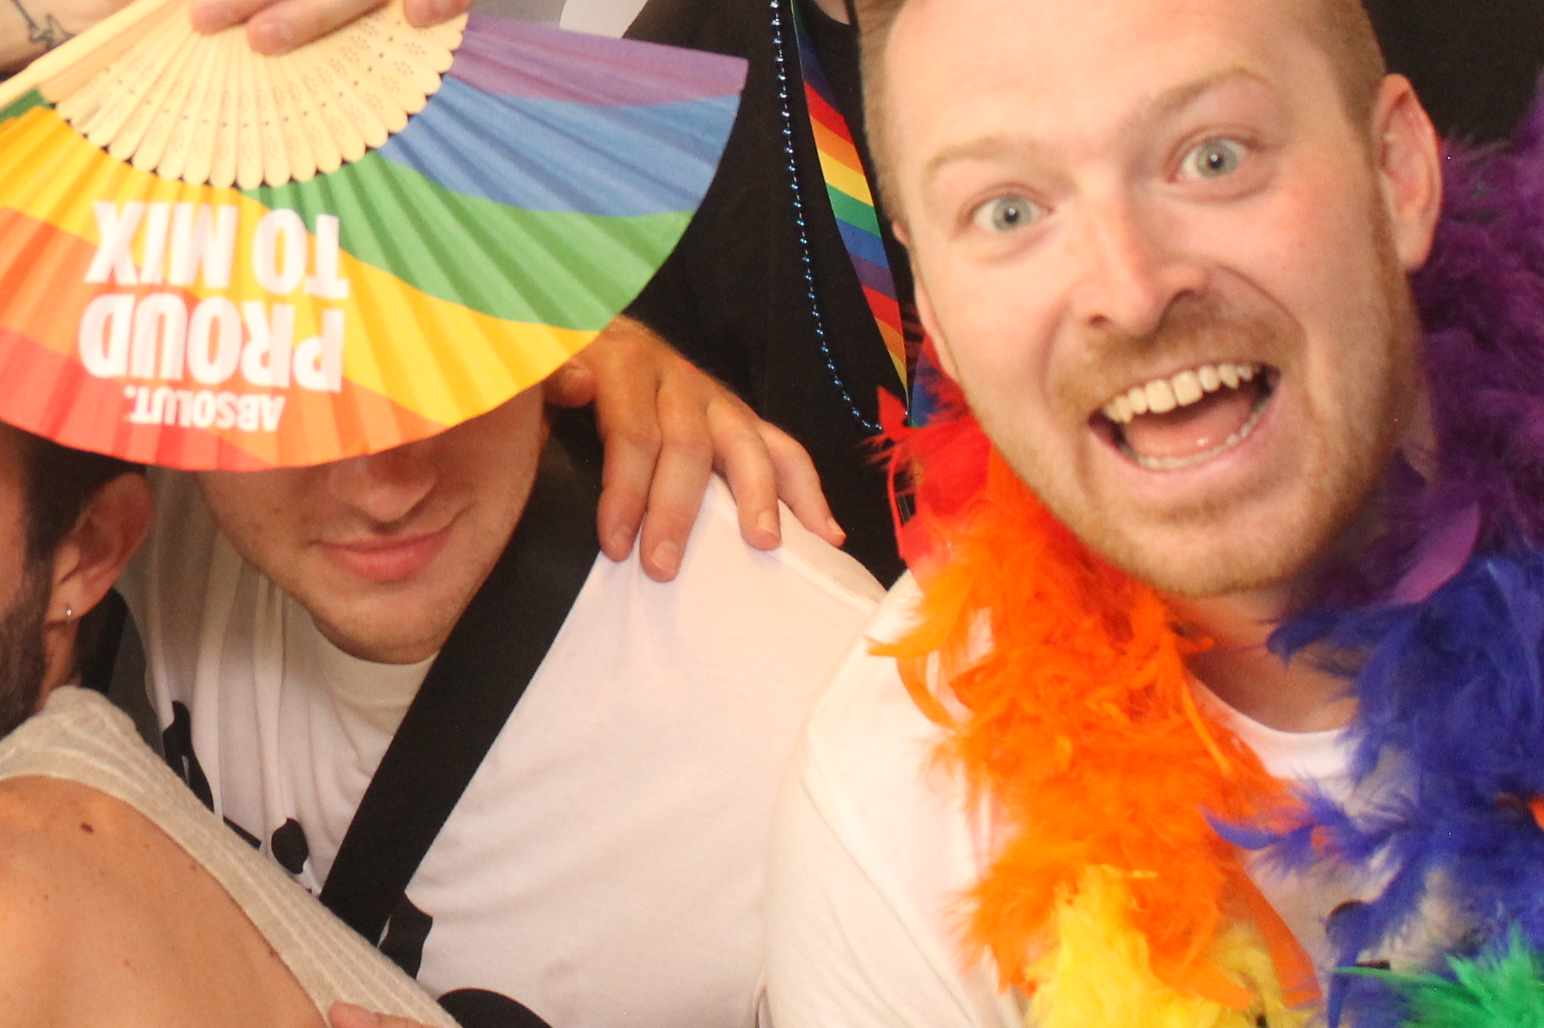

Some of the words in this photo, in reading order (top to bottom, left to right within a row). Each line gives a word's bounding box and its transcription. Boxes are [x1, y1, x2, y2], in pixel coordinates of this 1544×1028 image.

[83, 199, 239, 289] MIX
[252, 207, 350, 300] TO
[78, 292, 346, 394] PROUD
[122, 384, 286, 433] ABSOLUT.
